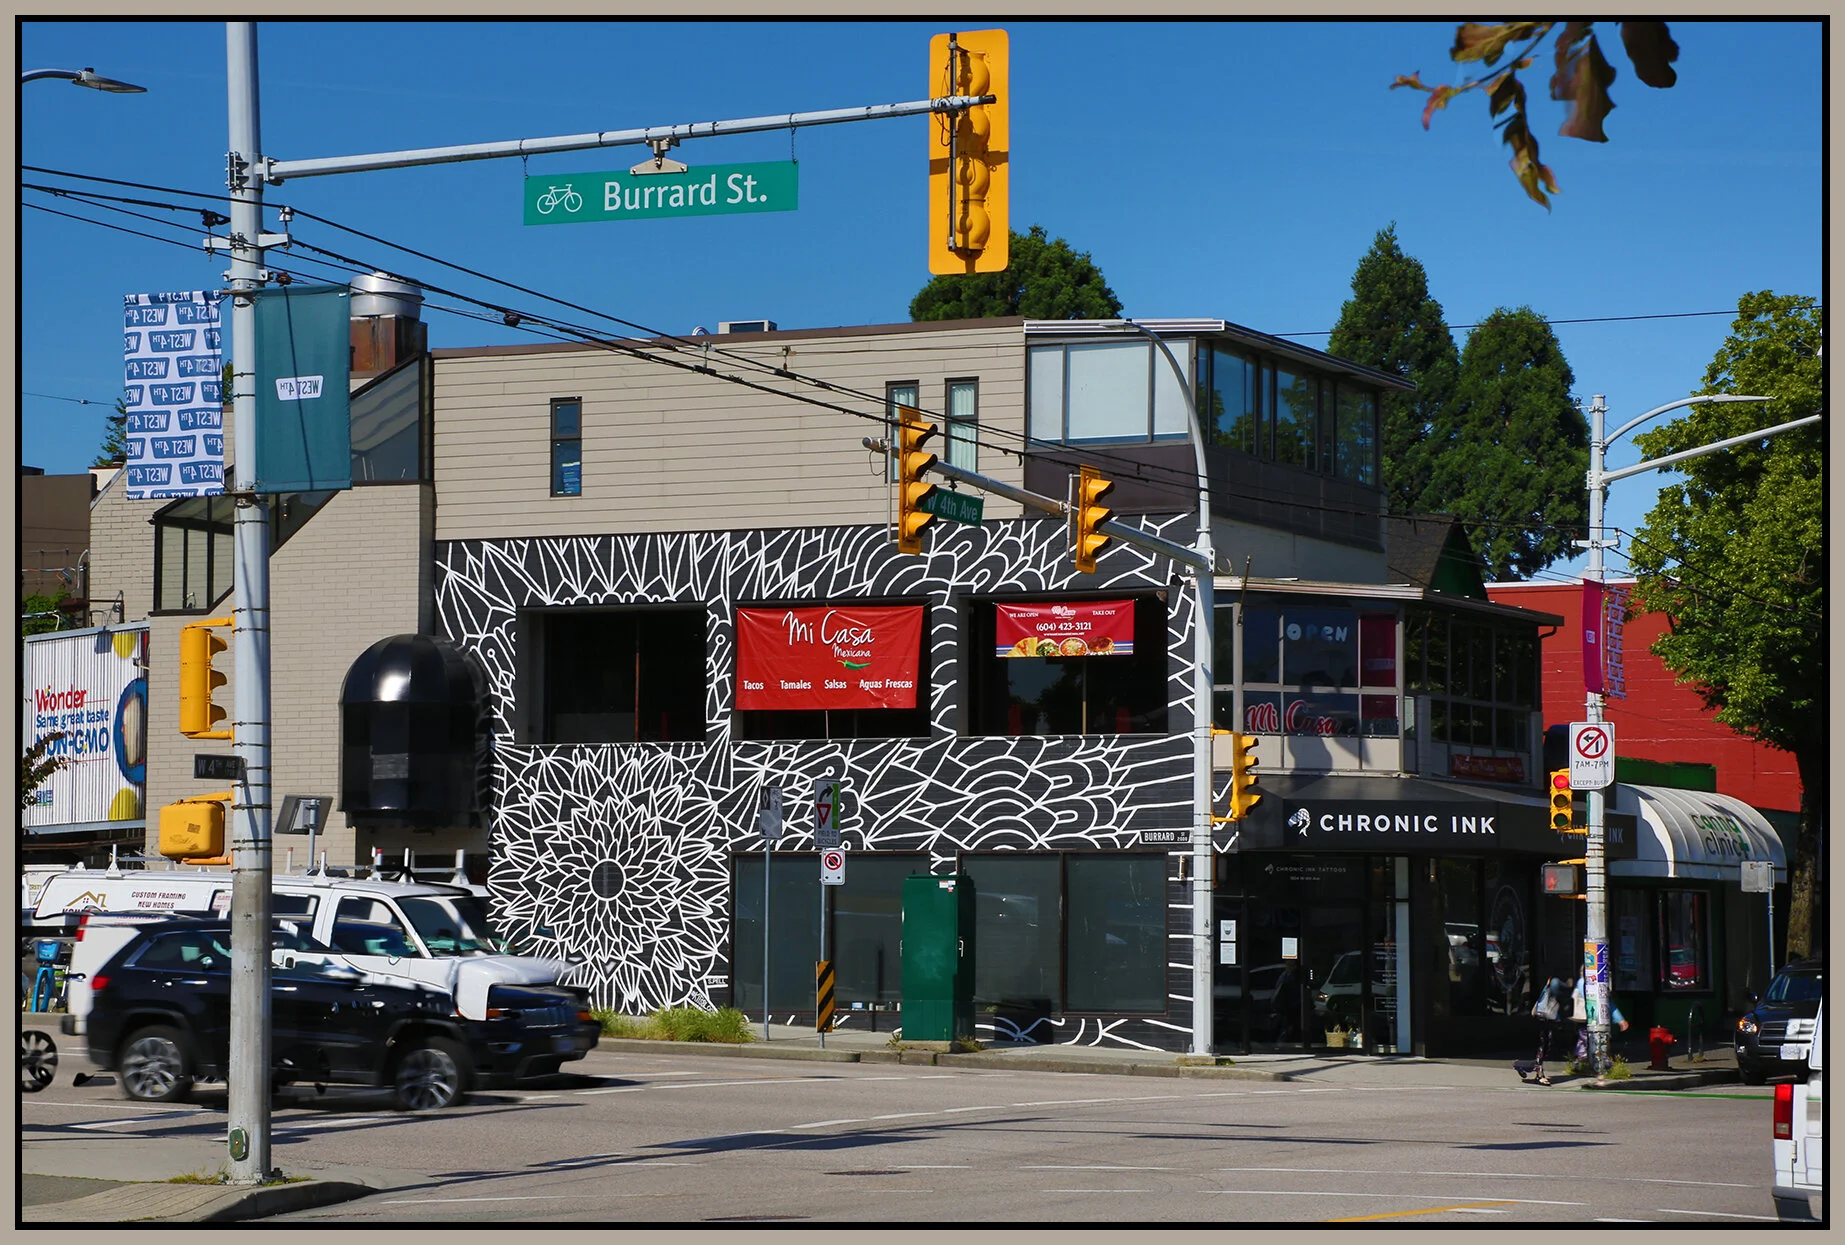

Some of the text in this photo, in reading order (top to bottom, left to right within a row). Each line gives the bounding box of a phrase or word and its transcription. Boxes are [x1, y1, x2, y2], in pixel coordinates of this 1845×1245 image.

[604, 173, 768, 211] Burrard St.
[927, 493, 977, 521] W 4th Ave
[782, 610, 875, 646] Mi Casa
[1036, 622, 1092, 632] (604) 423-3121
[832, 643, 871, 657] Mexicana
[744, 678, 913, 690] Tacos Tamales Salsas Aguas Frescas
[35, 684, 87, 712] Wonder
[37, 709, 109, 729] Same great taste
[1246, 700, 1342, 734] Mi Casa
[198, 760, 206, 774] W
[1576, 761, 1608, 769] 7AM-7PM
[1320, 814, 1495, 834] CHRONIC INK
[1690, 814, 1741, 833] canna
[1144, 832, 1175, 841] BURRARD
[1609, 828, 1623, 843] INK
[1705, 831, 1741, 856] clinic
[158, 892, 186, 900] FRAMING
